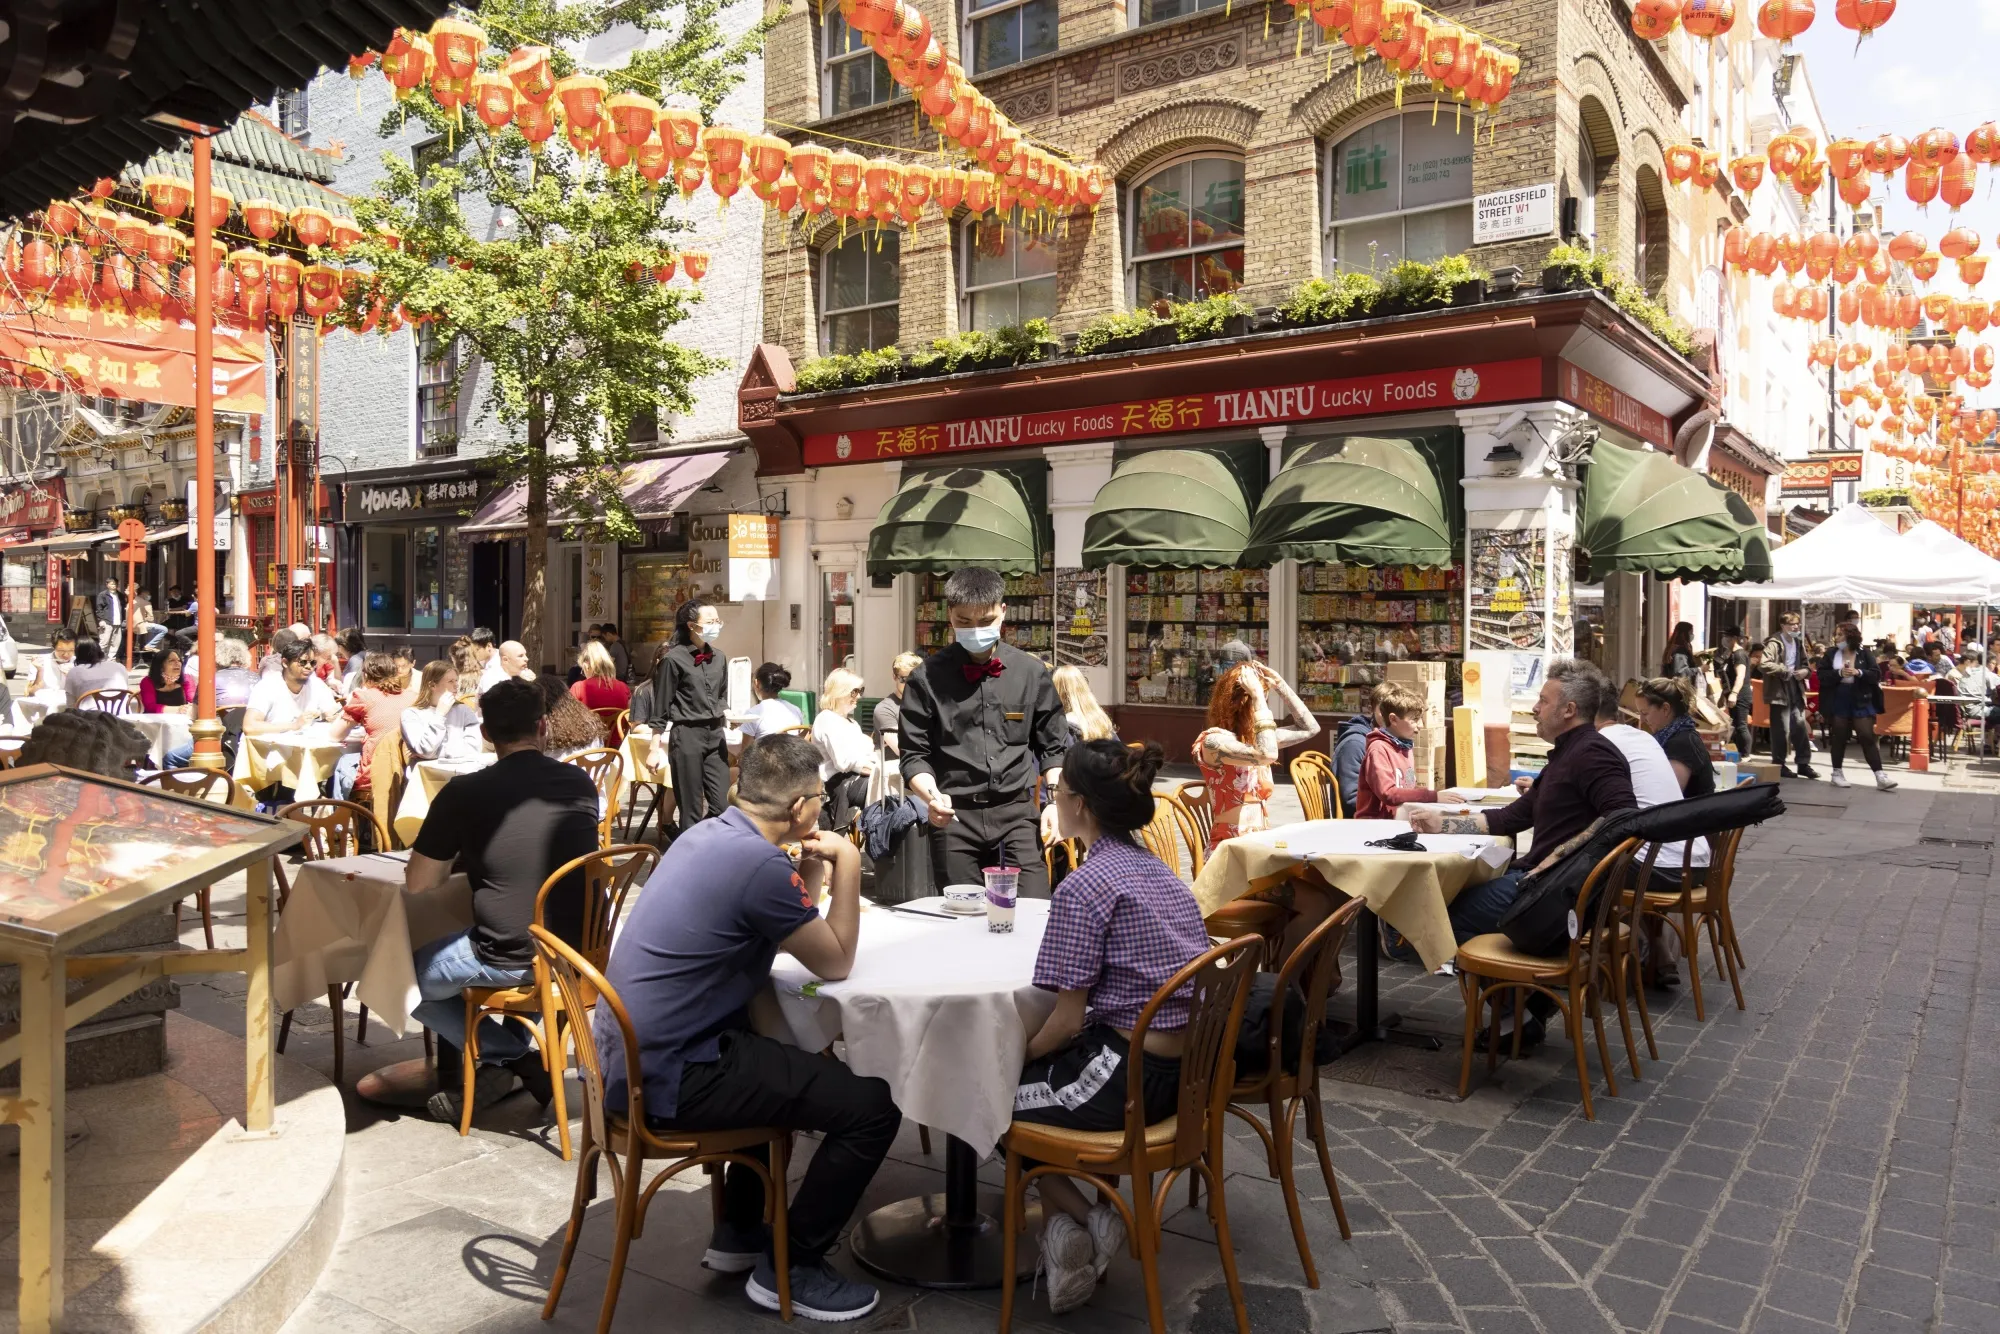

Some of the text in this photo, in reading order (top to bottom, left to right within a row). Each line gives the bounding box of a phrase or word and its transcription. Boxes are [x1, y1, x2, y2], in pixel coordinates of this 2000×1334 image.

[1345, 144, 1388, 194] 社
[1422, 161, 1438, 171] (020)
[1408, 170, 1450, 184] Fax: (020) 743
[1479, 189, 1547, 208] MACCLESFIELD
[1479, 203, 1529, 219] STREET W1
[1496, 230, 1525, 238] WESTMINSTER
[1585, 376, 1612, 417] 天福行
[1613, 390, 1642, 432] TIANFU
[876, 379, 1437, 456] 天福行 TIANFU Lucky Foods 天福行 TIANFU Lucky Foods
[361, 486, 412, 514] MONGA
[191, 519, 229, 527] Perian
[689, 517, 729, 541] GOLDE
[194, 538, 226, 546] EDS
[689, 549, 722, 574] GATE
